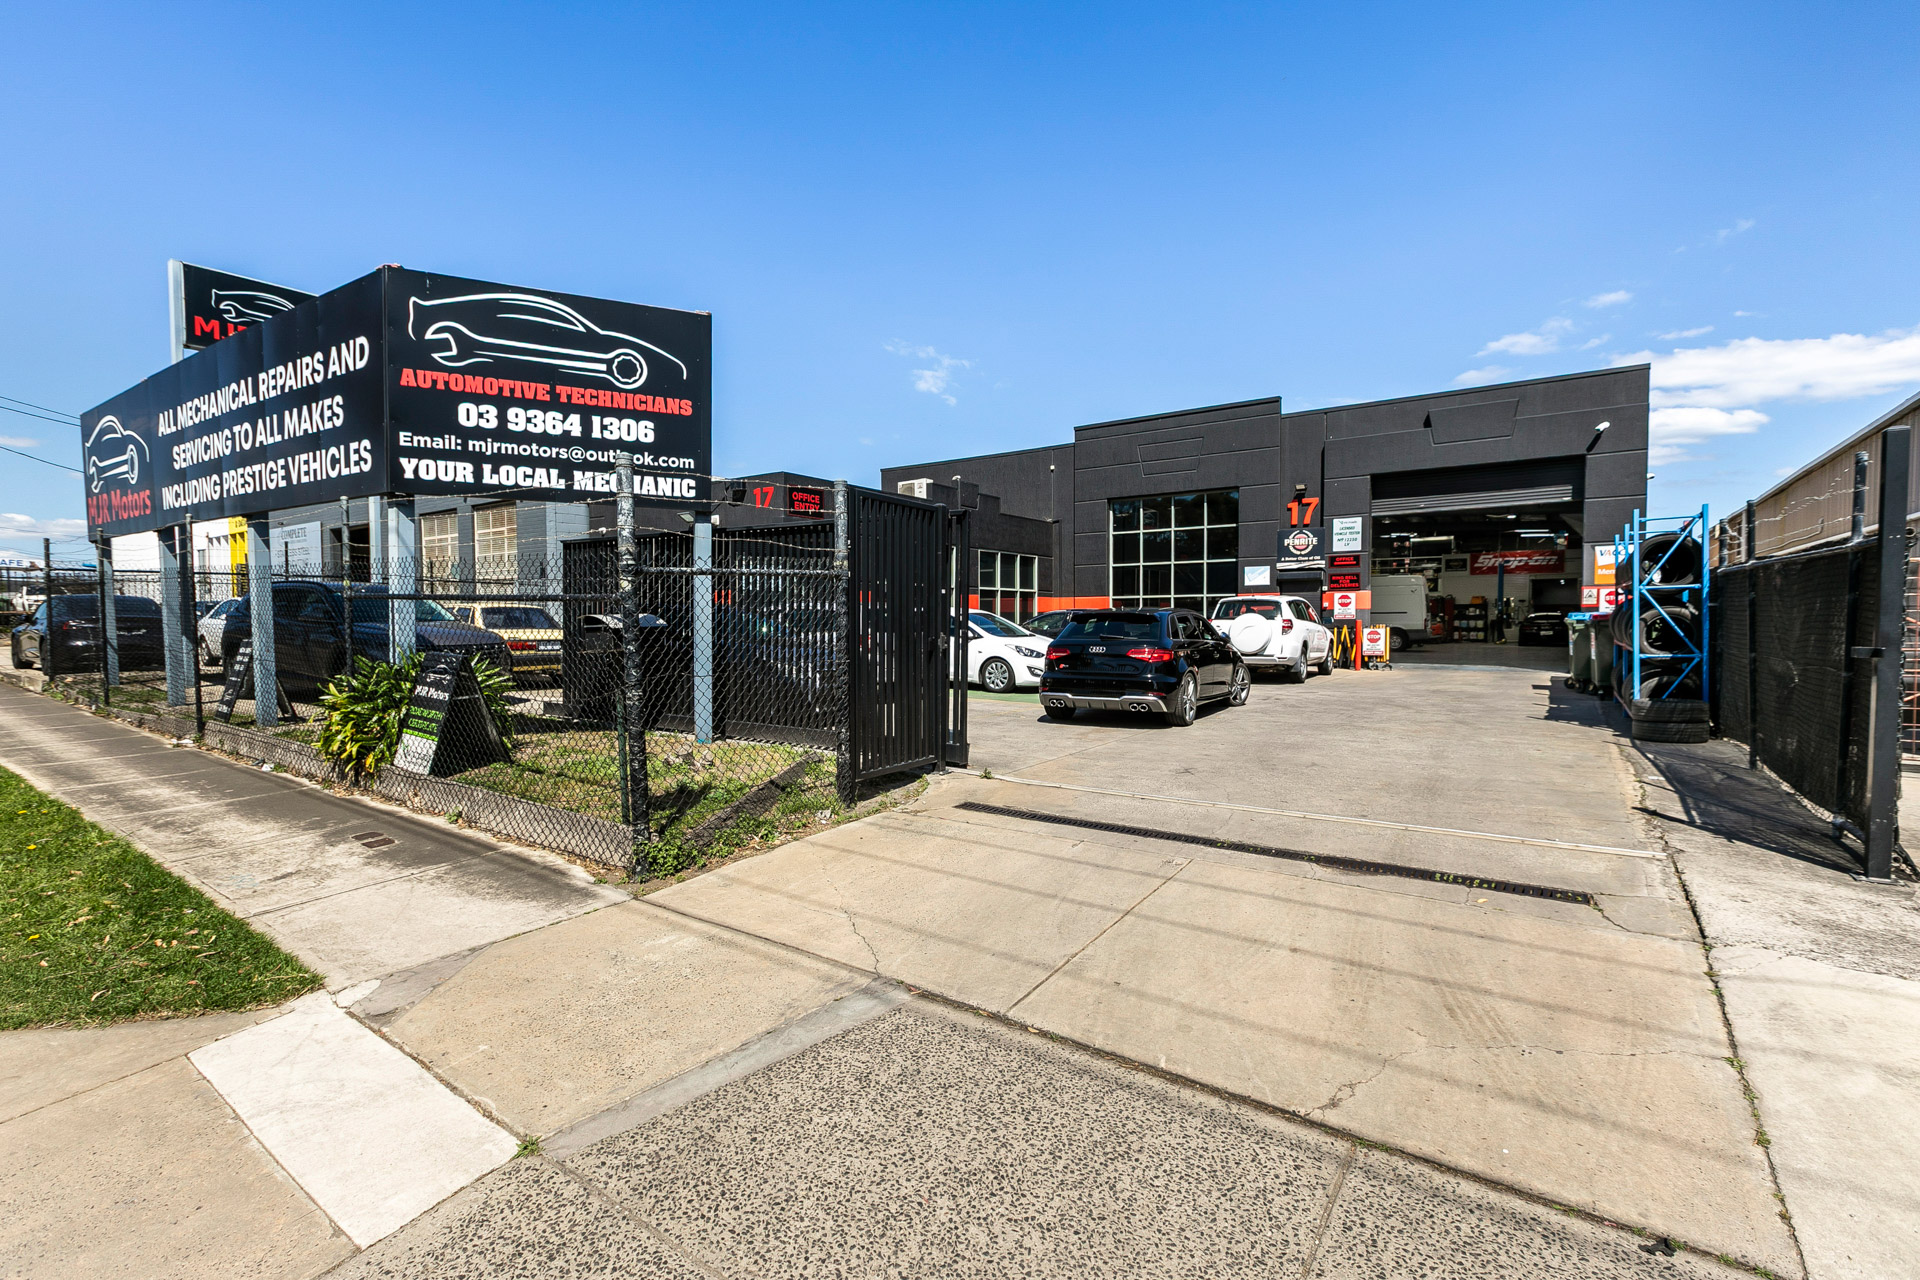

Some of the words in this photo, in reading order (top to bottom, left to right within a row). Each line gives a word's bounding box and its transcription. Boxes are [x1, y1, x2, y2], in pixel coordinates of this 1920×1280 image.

[157, 411, 177, 437] ALL
[177, 379, 257, 431] MECHANICAL
[258, 351, 324, 401] REPAIRS
[327, 335, 370, 380] AND
[399, 367, 551, 402] AUTOMOTIVE
[555, 384, 693, 417] TECHNICIANS
[172, 425, 232, 471] SERVICING
[232, 421, 252, 450] TO
[255, 411, 283, 448] ALL
[283, 394, 344, 433] MAKES
[457, 401, 498, 429] 03
[506, 405, 582, 438] 9364
[591, 415, 655, 443] 1306
[399, 431, 463, 451] Email:
[467, 438, 695, 470] mjrmotors@outok.com
[162, 473, 221, 511] INCLUDING
[222, 461, 287, 498] PRESTIGE
[288, 439, 372, 486] VEHICLES
[399, 456, 475, 484] YOUR
[482, 464, 566, 489] LOCAL
[87, 493, 111, 526] MJR
[110, 488, 152, 522] Motors
[752, 486, 775, 509] 17
[792, 491, 820, 504] OFFICE
[794, 501, 820, 513] ENTRY
[1287, 497, 1320, 526] 17
[280, 526, 308, 541] COMPLETE
[1284, 537, 1318, 547] PENRITE
[1474, 555, 1558, 569] Snap-on
[414, 685, 429, 698] MJR
[427, 687, 450, 701] Motors
